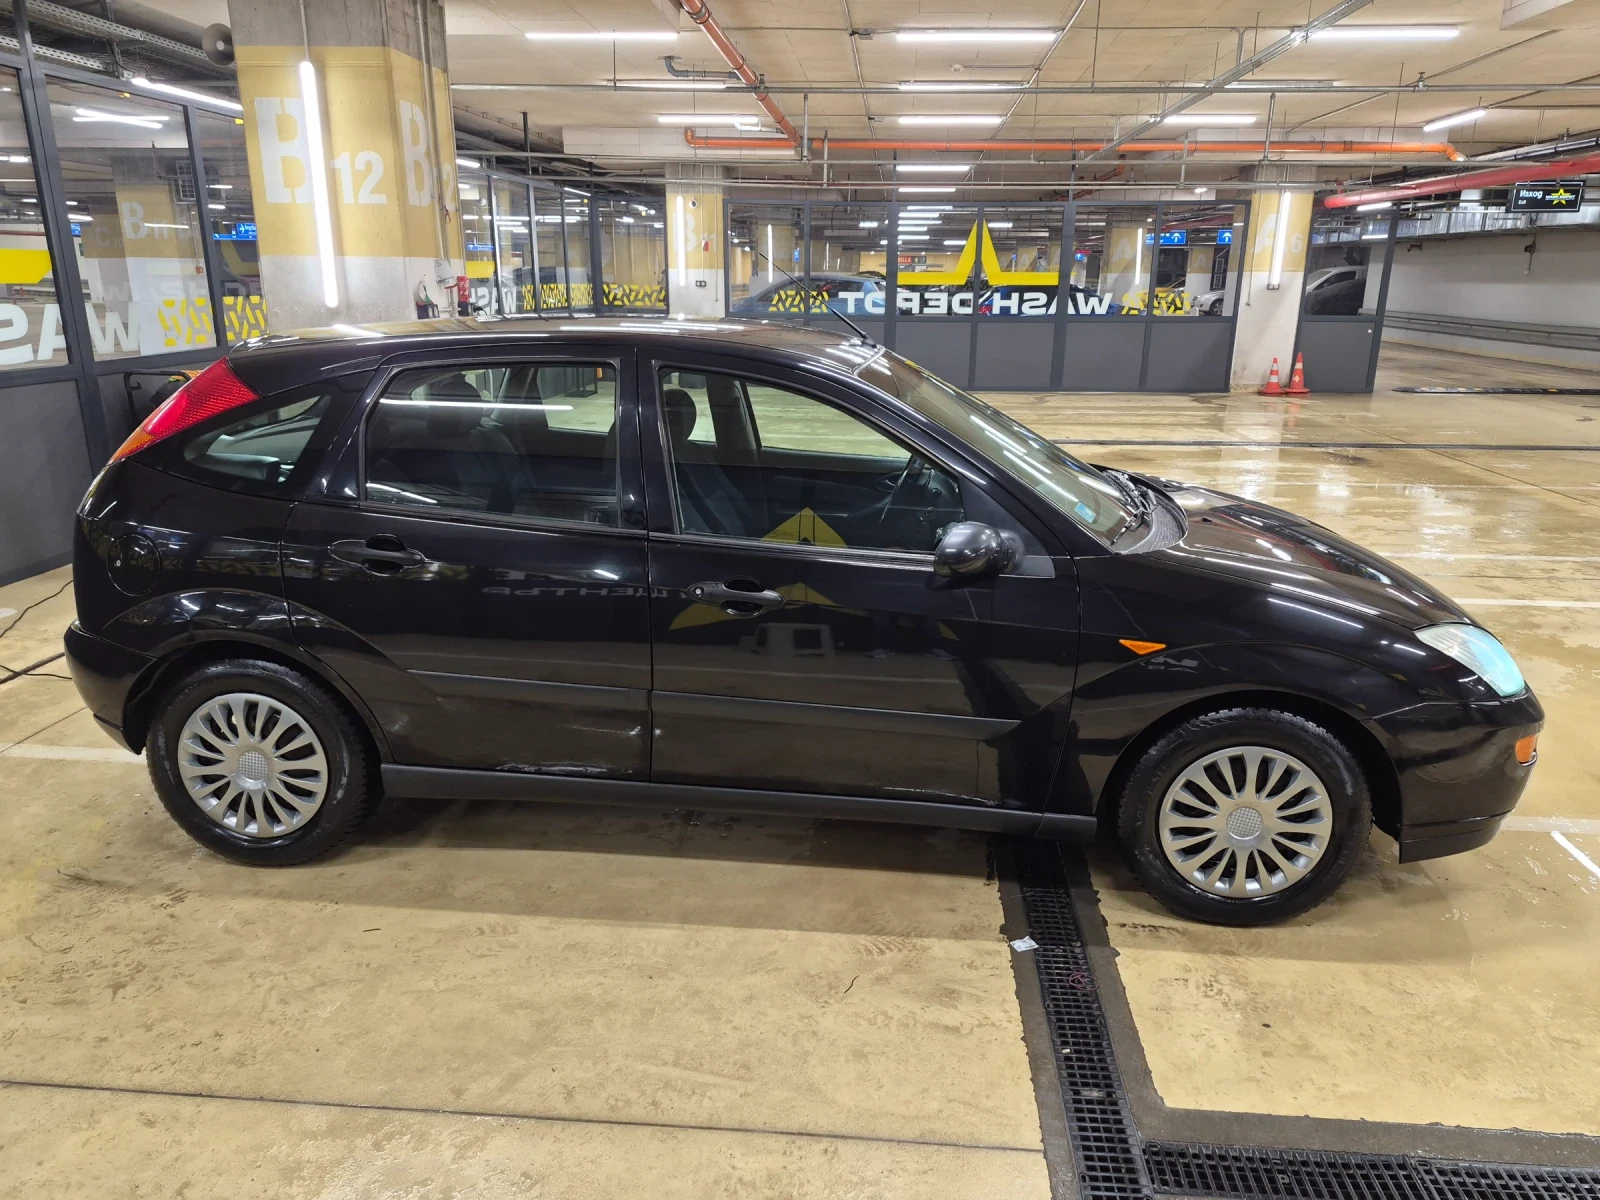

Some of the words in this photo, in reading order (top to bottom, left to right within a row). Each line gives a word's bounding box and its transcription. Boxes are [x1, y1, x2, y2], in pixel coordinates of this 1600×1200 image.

[254, 97, 314, 204] B
[329, 150, 388, 205] 12
[399, 99, 433, 207] B
[121, 201, 146, 239] B
[1290, 232, 1304, 254] 6
